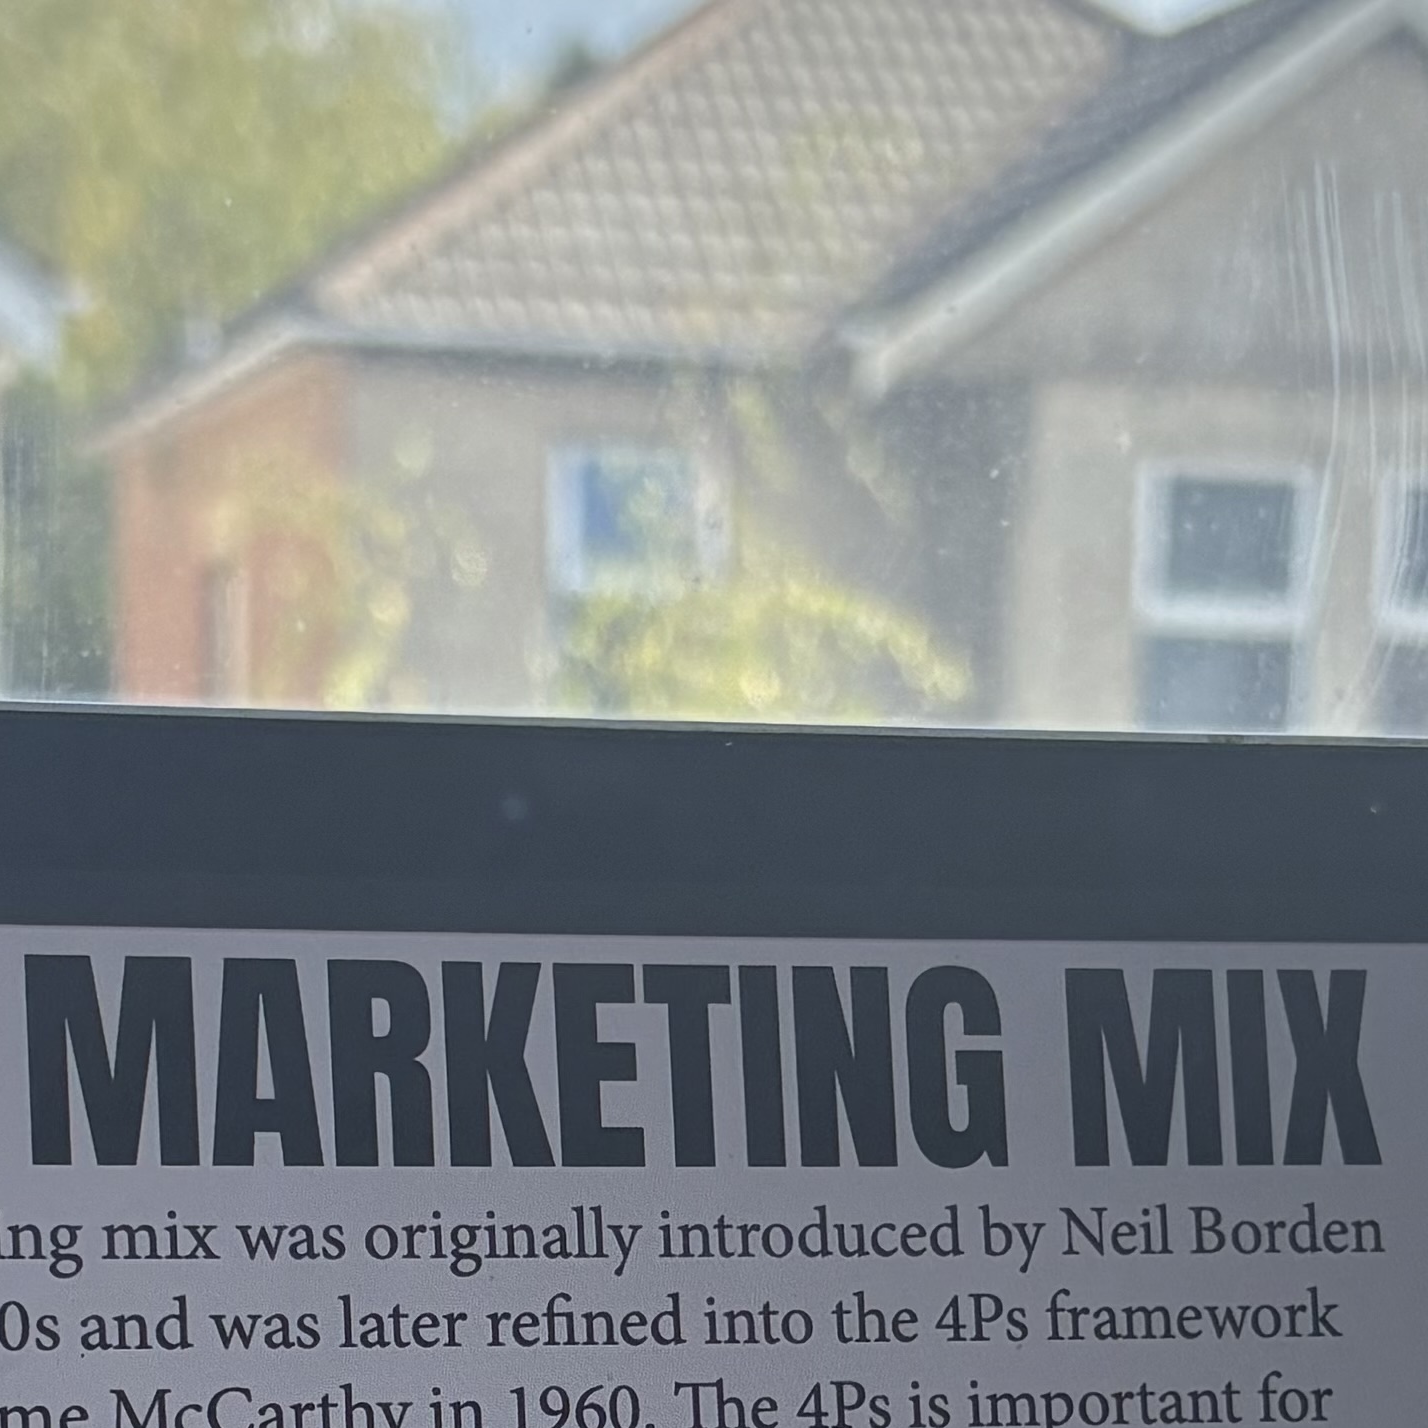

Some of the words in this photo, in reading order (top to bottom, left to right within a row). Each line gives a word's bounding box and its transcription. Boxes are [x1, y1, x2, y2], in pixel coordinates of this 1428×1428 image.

[24, 954, 1008, 1169] MARKETING
[1065, 968, 1382, 1166] MIX
[102, 1210, 220, 1259] mix
[236, 1225, 345, 1260] was
[365, 1205, 642, 1277] originally
[659, 1205, 964, 1258] introduced
[979, 1204, 1045, 1273] by
[1060, 1204, 1173, 1255] Neil
[1189, 1202, 1385, 1254] Borden
[797, 1381, 891, 1428] 4Ps
[909, 1381, 950, 1428] is
[1258, 1371, 1333, 1422] for
